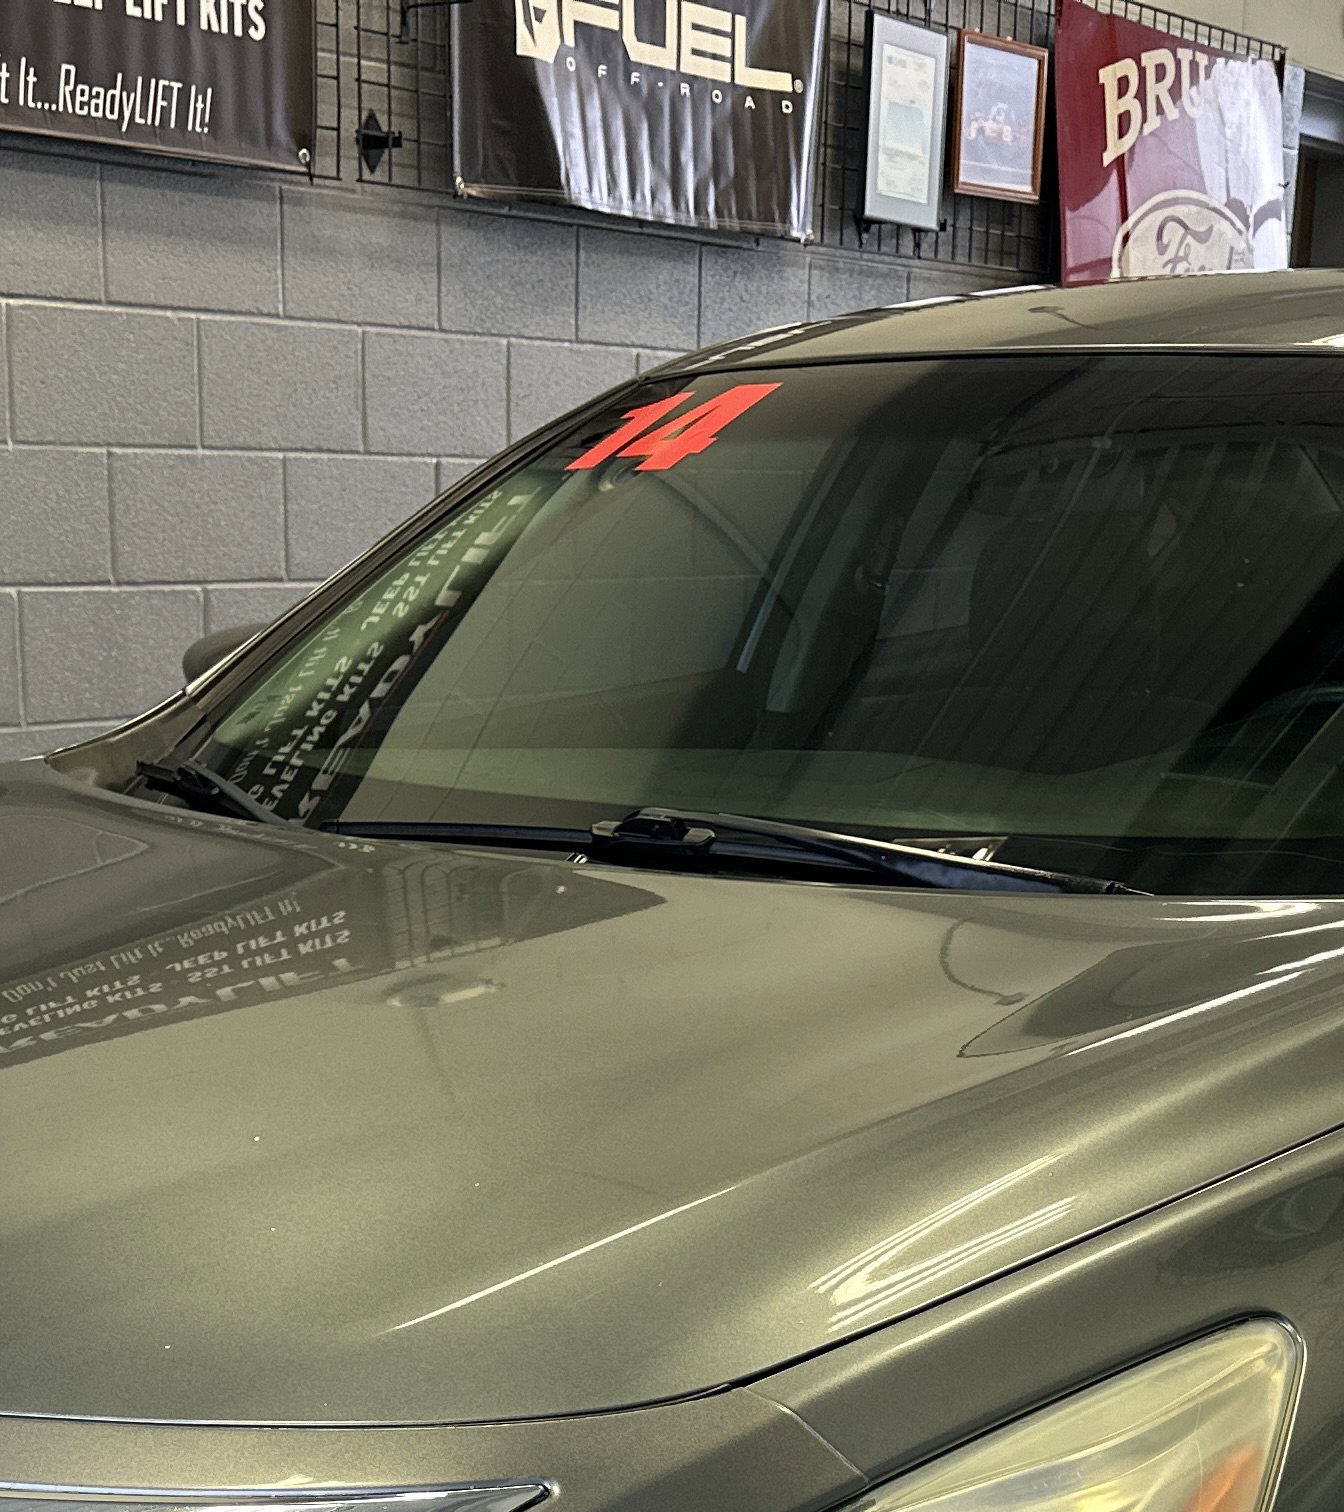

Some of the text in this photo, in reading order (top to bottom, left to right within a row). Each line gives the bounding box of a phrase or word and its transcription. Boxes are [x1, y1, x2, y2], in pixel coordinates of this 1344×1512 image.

[199, 0, 267, 41] KITS
[560, 0, 794, 93] FUEL
[187, 84, 213, 134] It!
[565, 382, 784, 471] 14
